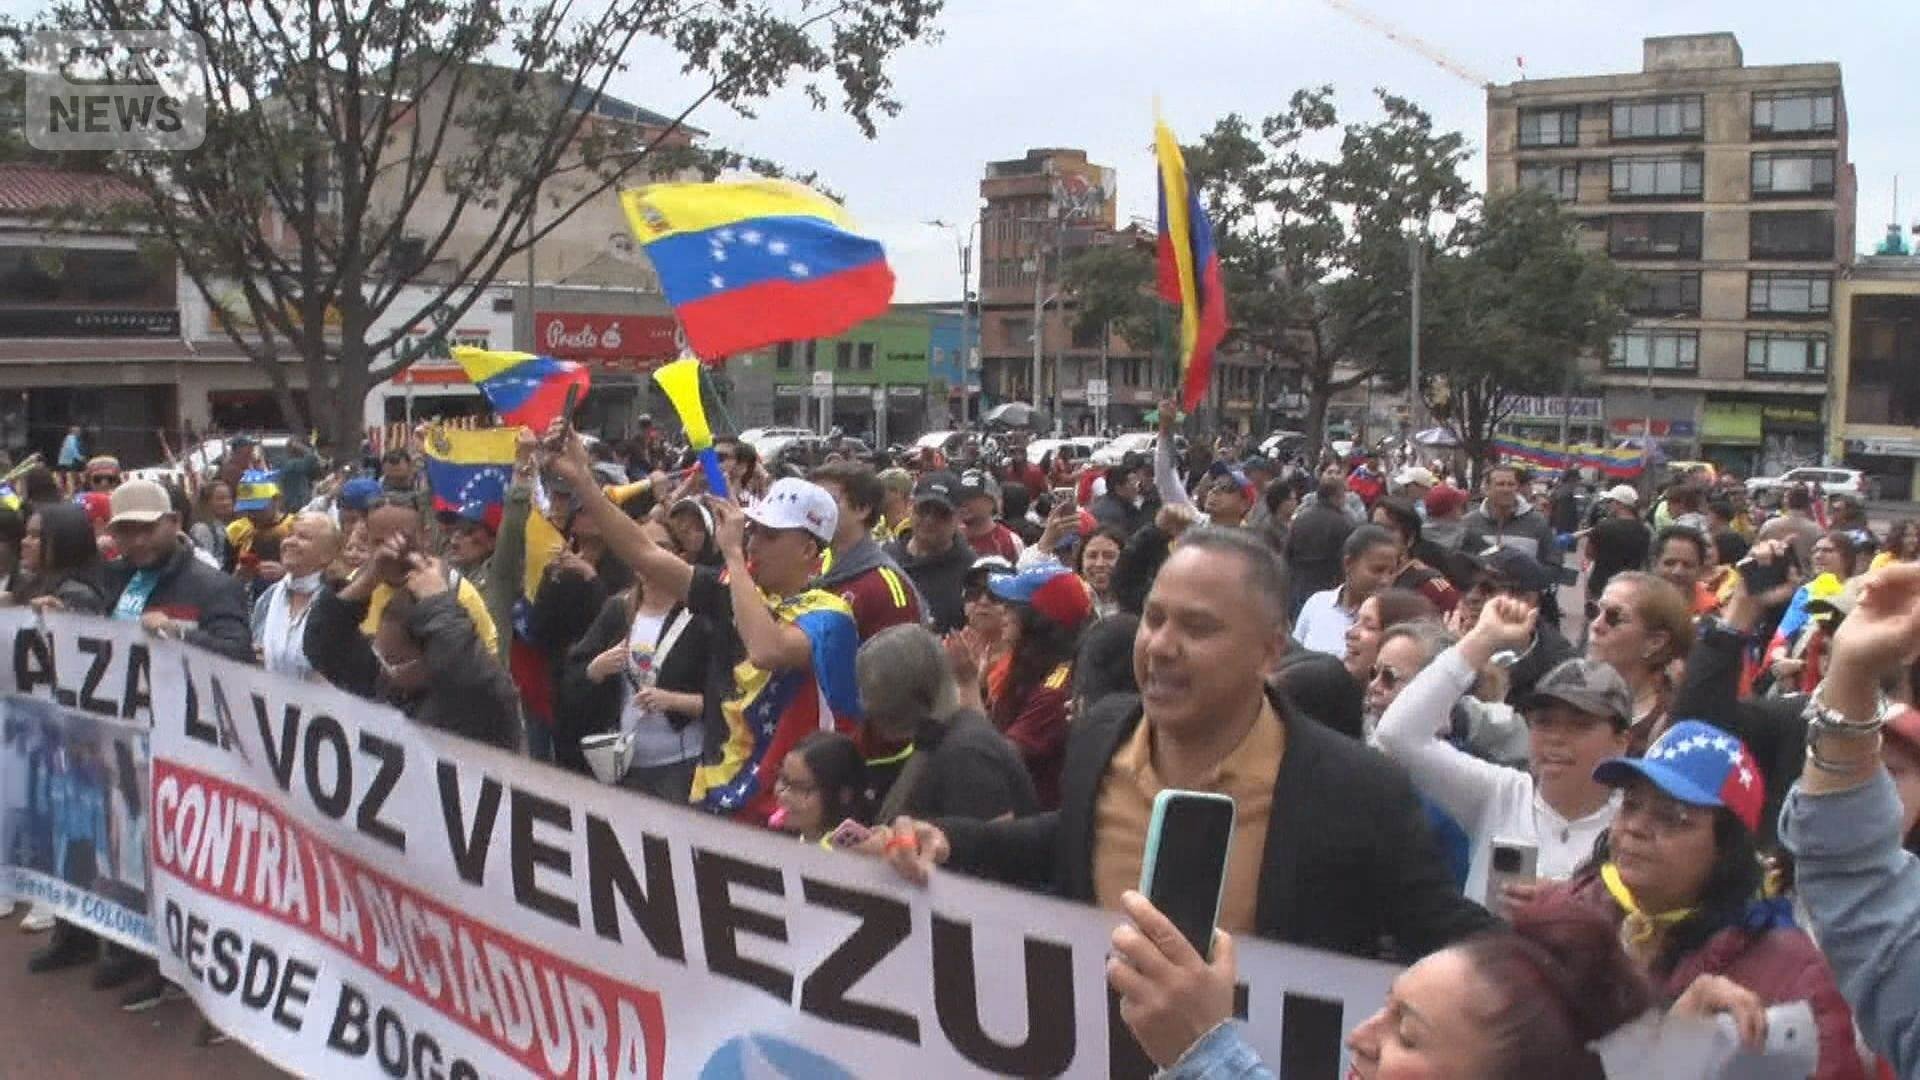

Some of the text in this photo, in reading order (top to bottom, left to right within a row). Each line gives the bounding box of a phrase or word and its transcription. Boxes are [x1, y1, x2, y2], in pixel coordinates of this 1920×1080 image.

[547, 319, 597, 348] Presto
[14, 627, 155, 728] ALZA
[251, 692, 406, 853] VOZ
[436, 760, 1344, 1080] VENEZU
[156, 777, 650, 1080] CONTRA LA DICTADURA
[164, 899, 319, 1032] DESDE
